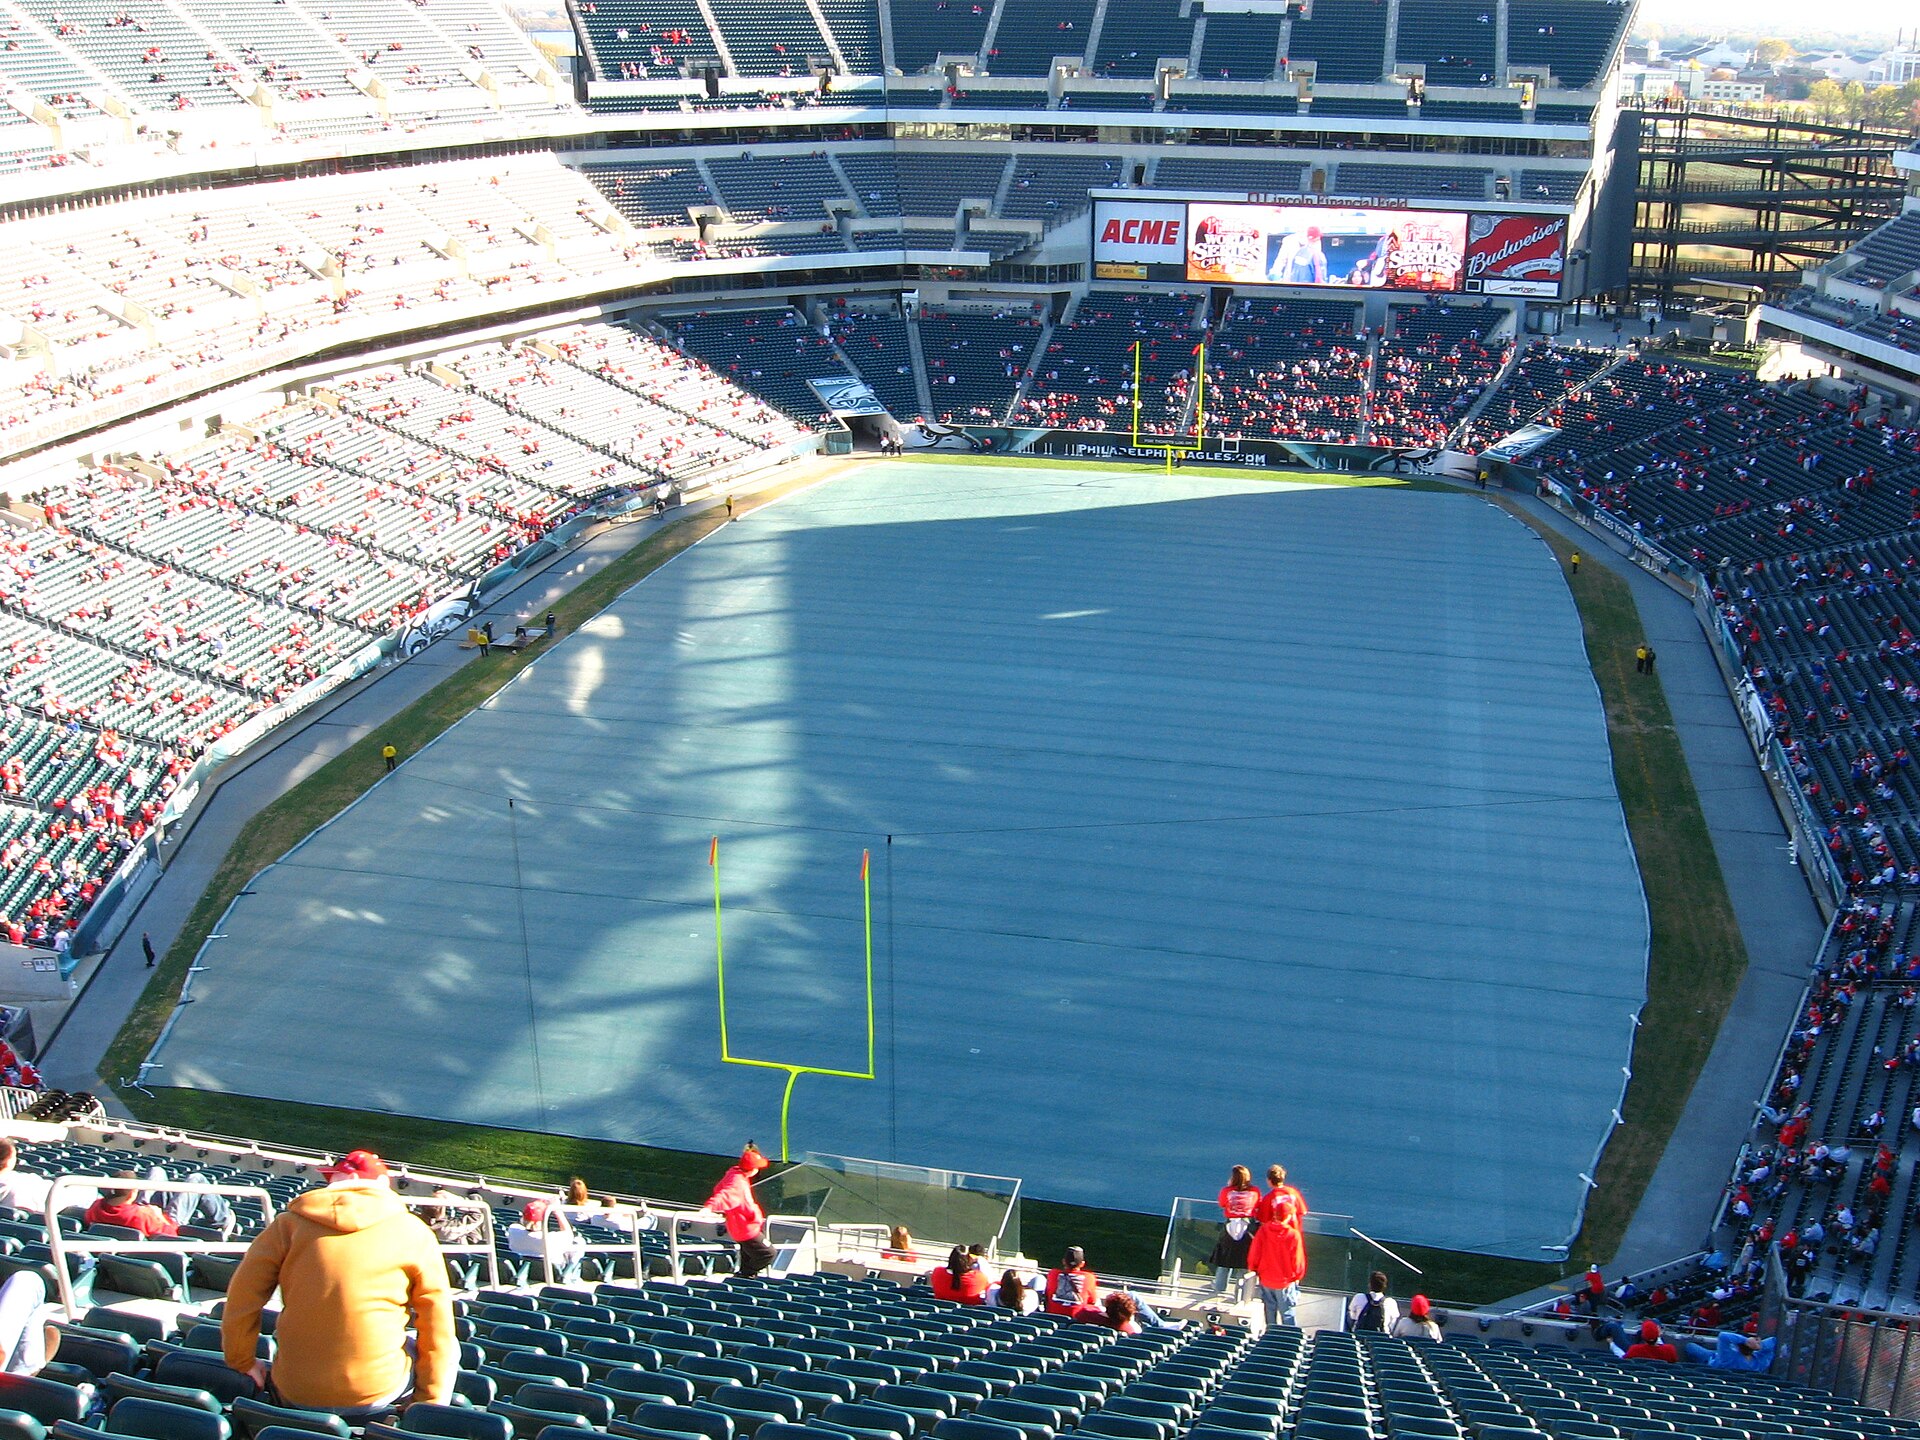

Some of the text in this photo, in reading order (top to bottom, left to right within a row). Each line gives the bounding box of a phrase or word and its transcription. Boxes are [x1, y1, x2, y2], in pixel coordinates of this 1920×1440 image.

[1264, 193, 1408, 207] Lincoln Financial Field
[1100, 219, 1180, 245] ACME
[1193, 243, 1261, 260] SERIES
[1401, 242, 1453, 253] WORLD
[1467, 218, 1564, 276] Budweiser
[1389, 251, 1462, 271] SERIES
[812, 378, 857, 386] GEICO
[8, 413, 90, 449] PHILADELPHIA
[93, 395, 144, 421] PHILLIES!
[149, 386, 170, 403] 2008
[173, 374, 206, 393] WORLD
[210, 363, 241, 382] SERIES
[1594, 509, 1614, 530] EAGLES
[1615, 522, 1633, 543] YOUTH
